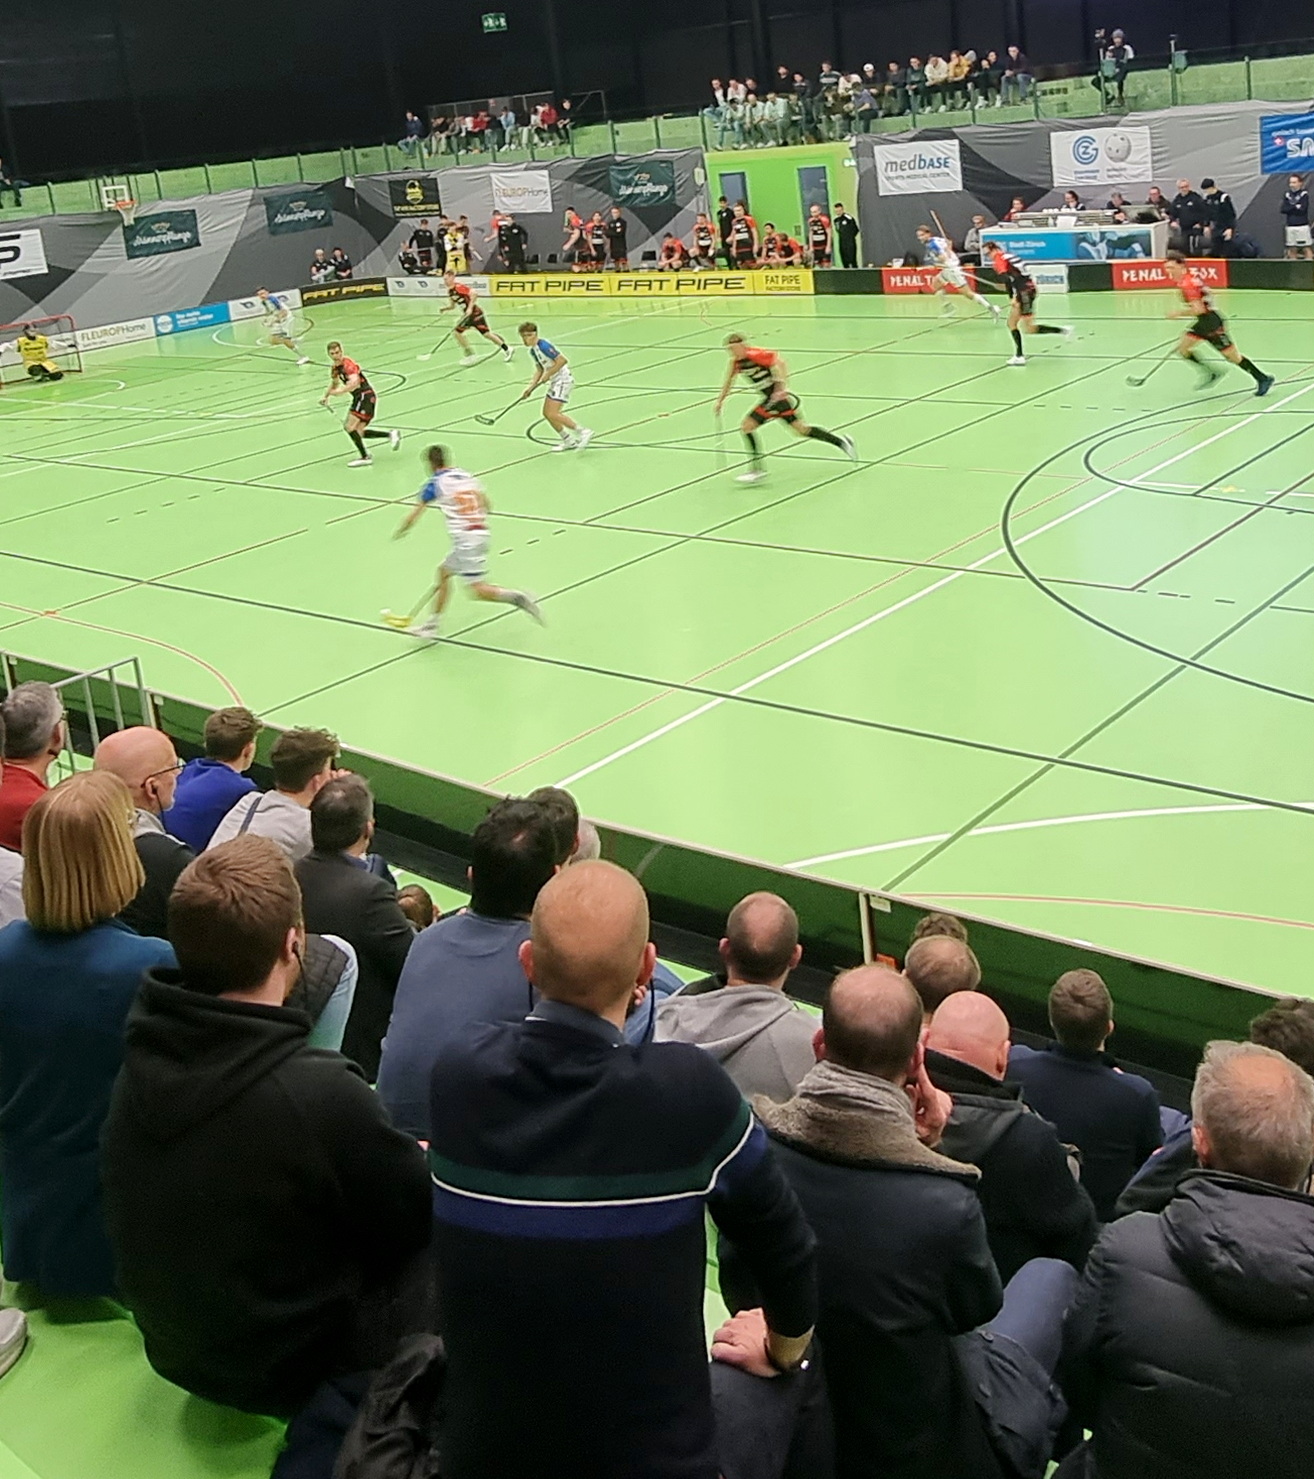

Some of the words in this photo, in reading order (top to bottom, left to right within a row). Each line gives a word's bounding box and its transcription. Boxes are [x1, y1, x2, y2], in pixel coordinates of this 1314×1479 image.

[496, 281, 541, 292] FAT
[545, 280, 604, 292] PIPE
[617, 279, 671, 291] FAT
[676, 277, 746, 291] PIPE
[765, 275, 781, 285] FAT
[782, 275, 801, 285] PIPE
[890, 275, 933, 287] PENALT
[303, 287, 340, 301] FAT
[340, 283, 386, 296] PIPE
